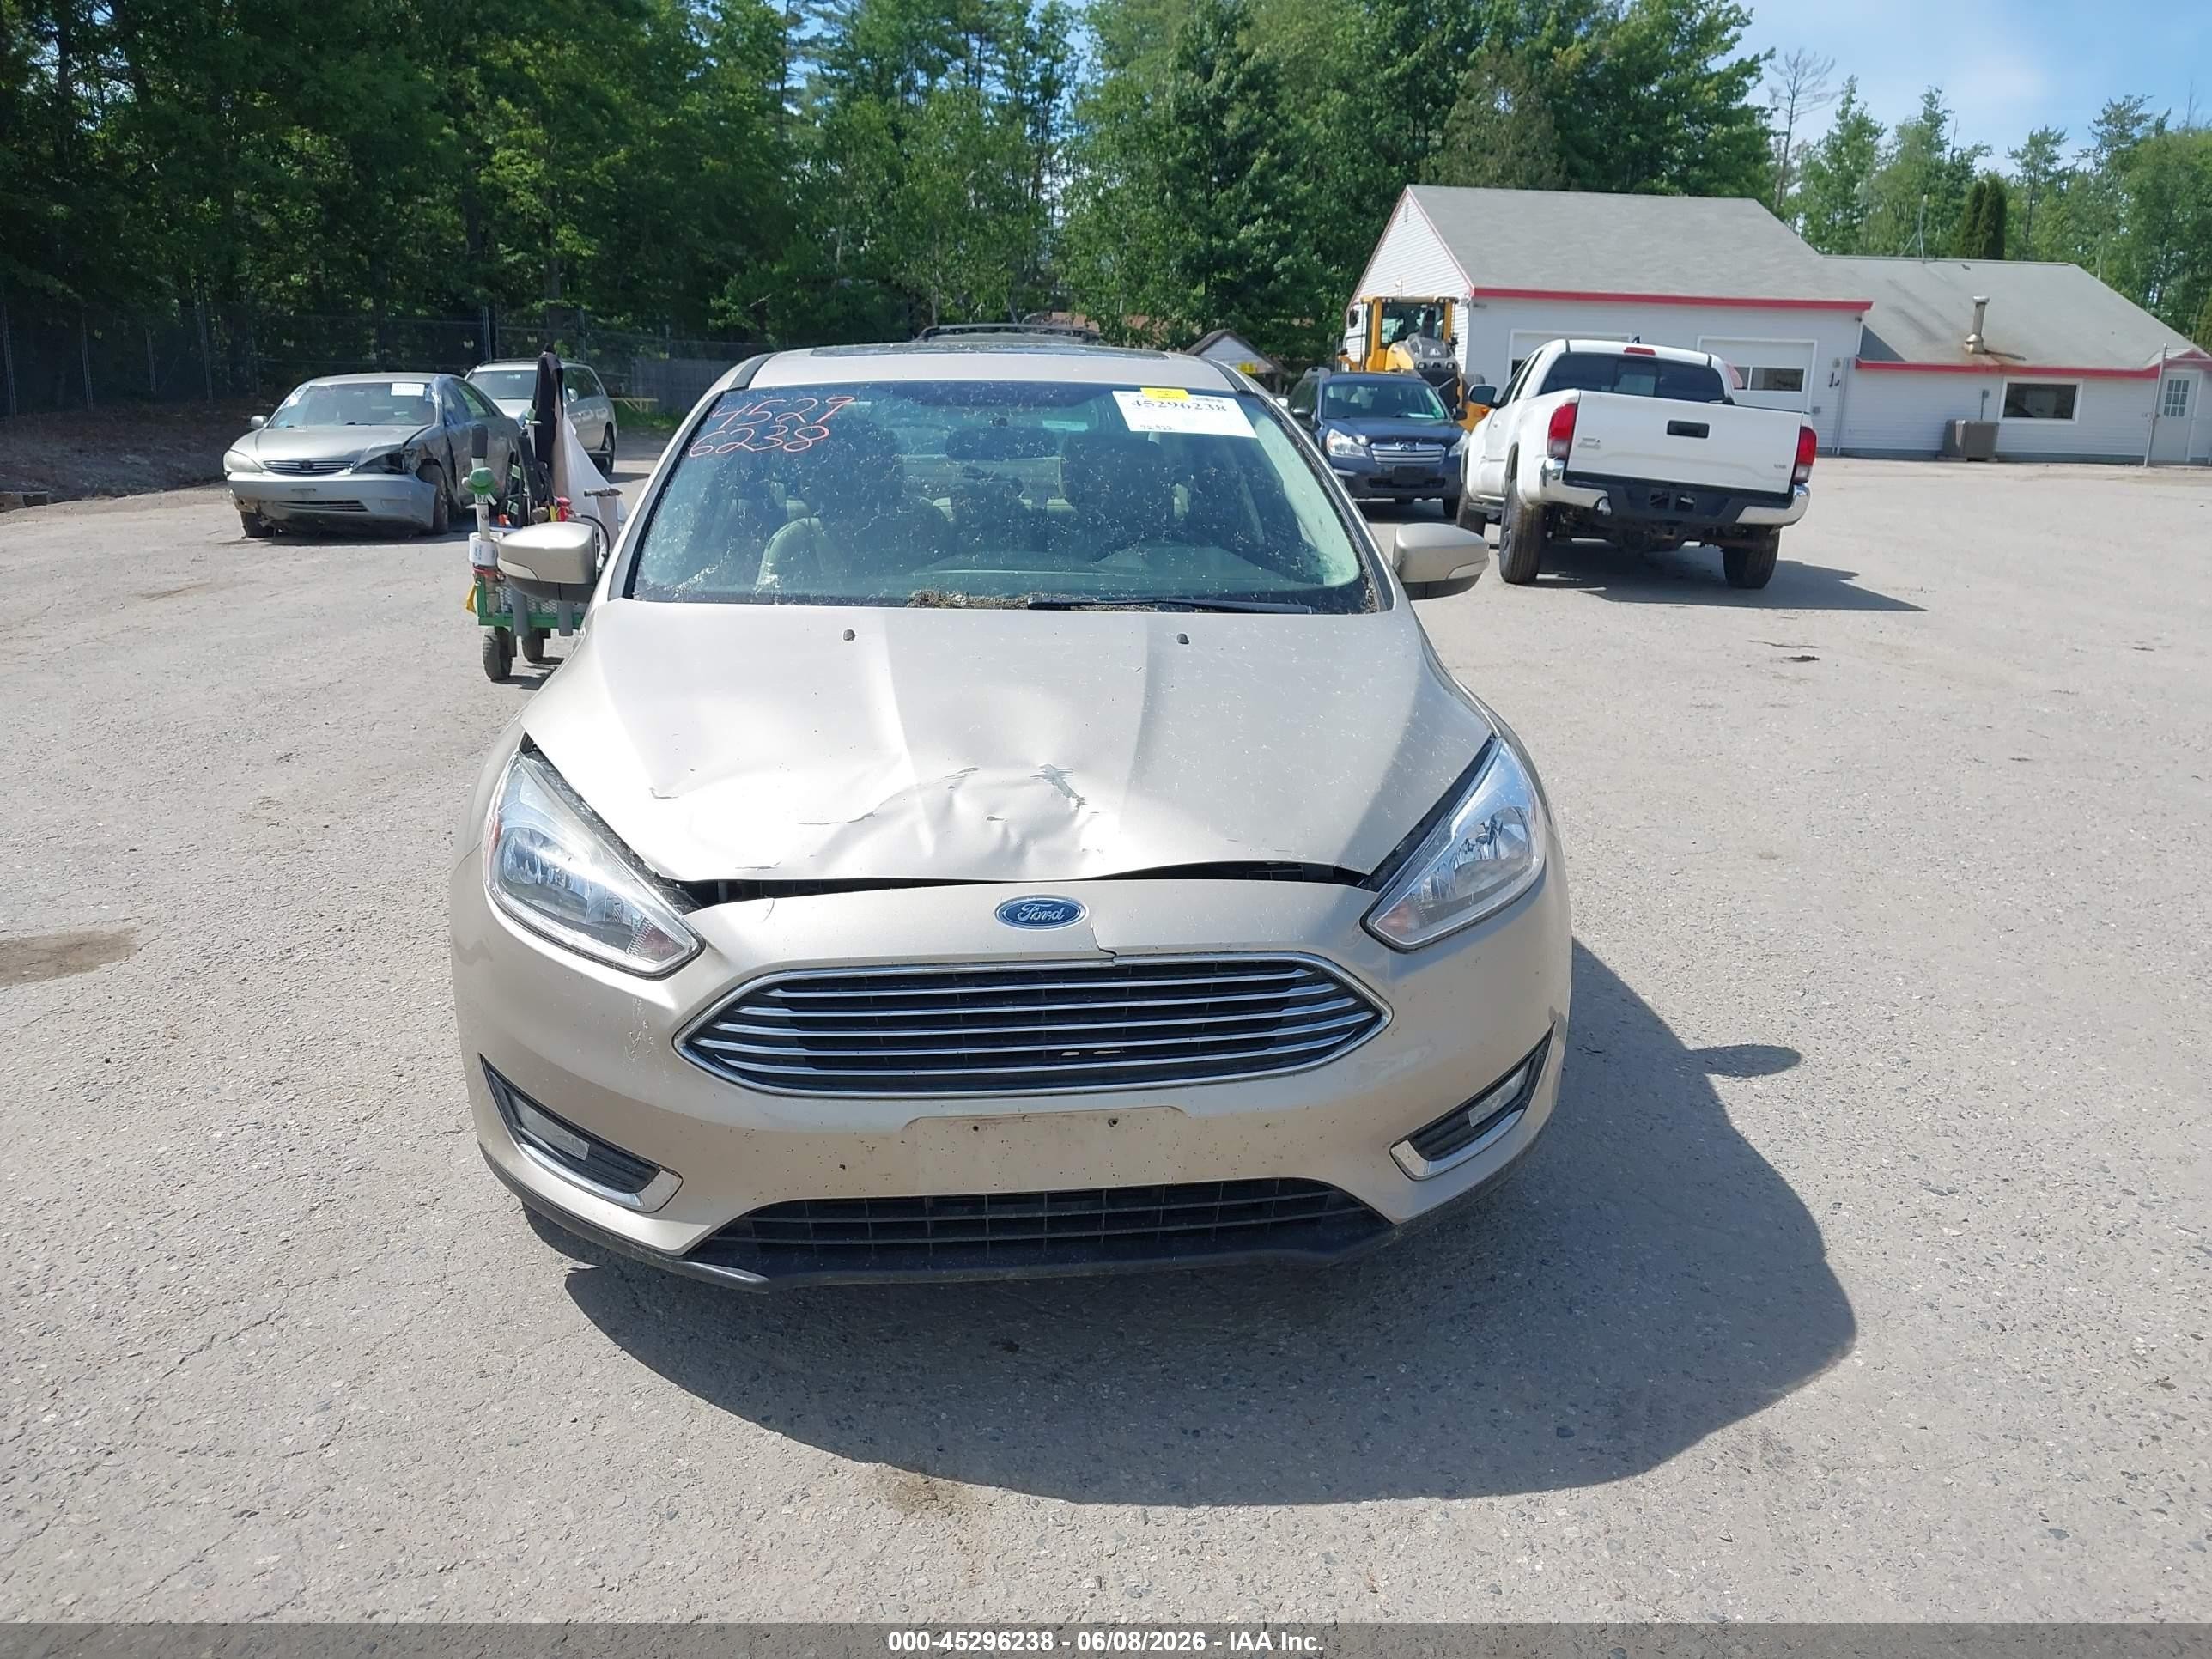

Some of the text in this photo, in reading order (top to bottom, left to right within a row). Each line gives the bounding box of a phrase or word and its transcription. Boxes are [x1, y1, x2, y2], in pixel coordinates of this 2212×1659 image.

[710, 396, 856, 430] 4529
[689, 424, 830, 458] 6238
[1017, 903, 1066, 921] Ford
